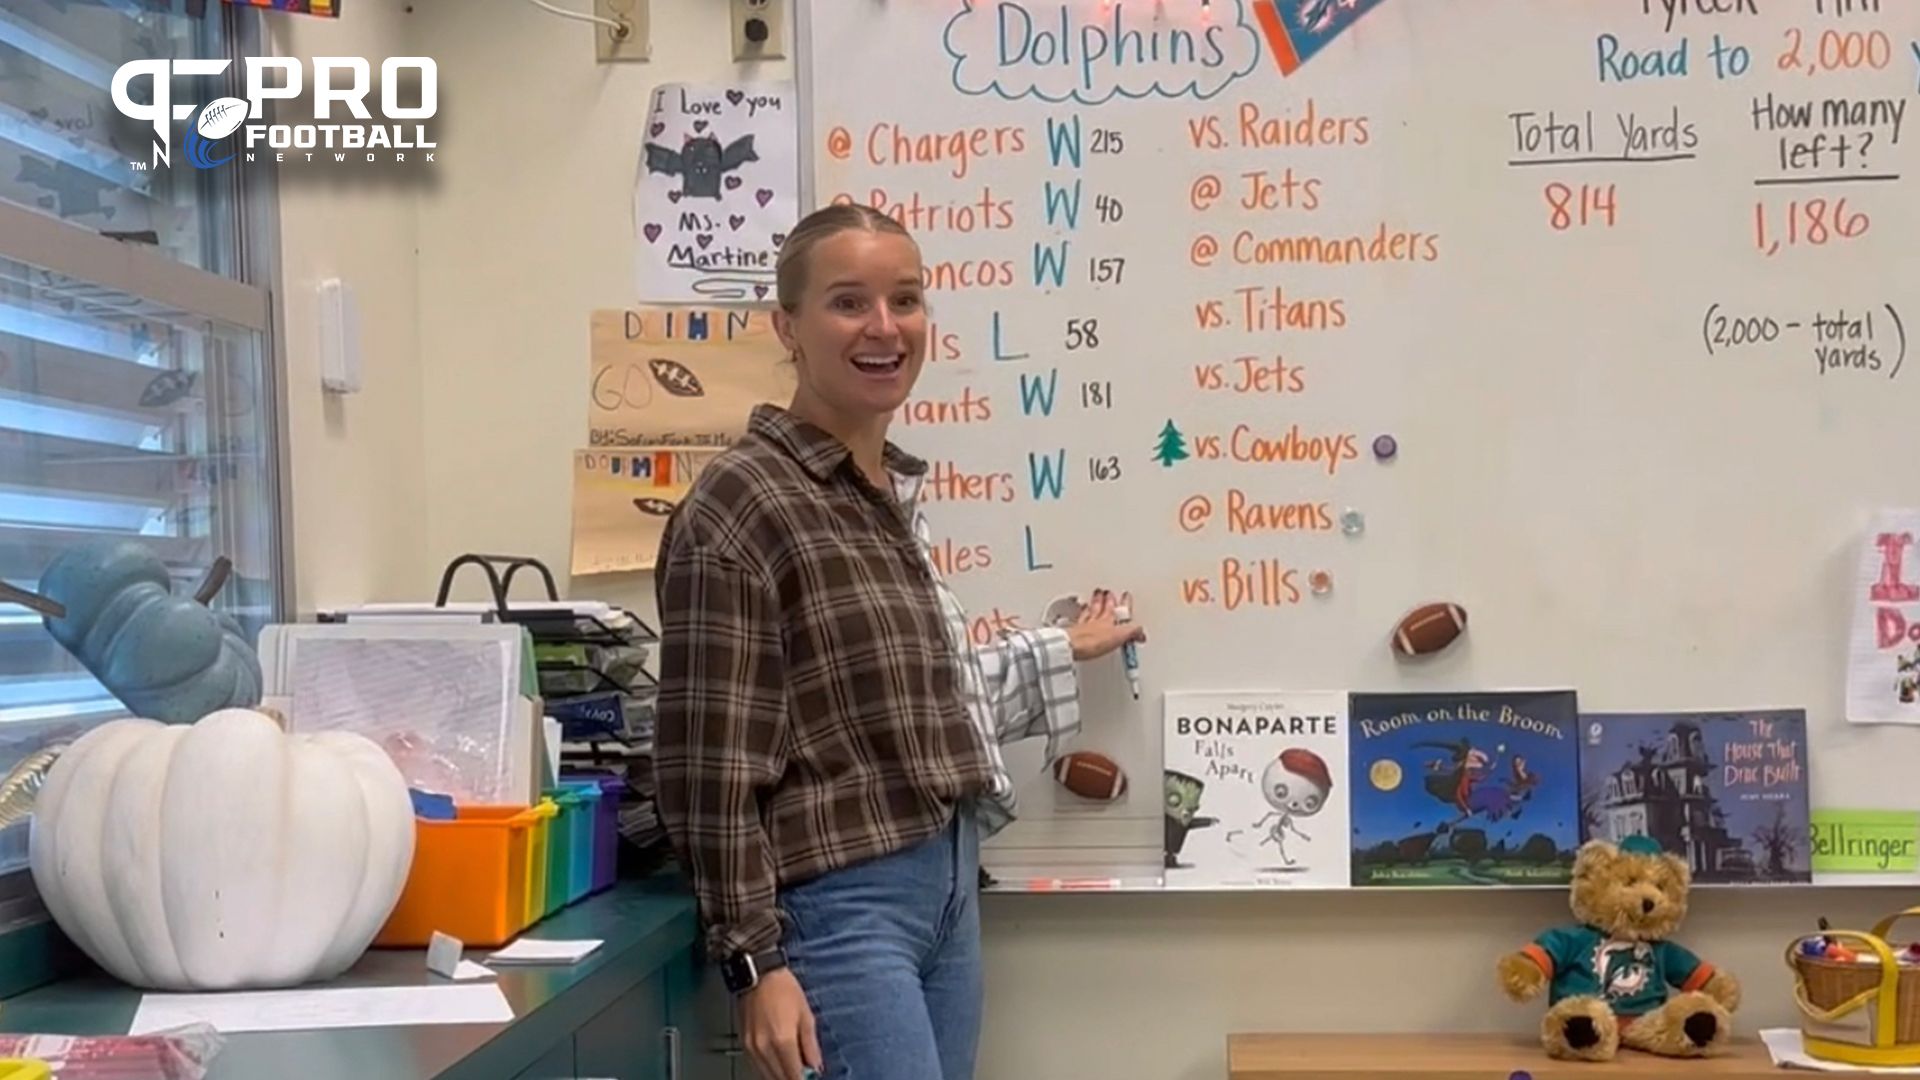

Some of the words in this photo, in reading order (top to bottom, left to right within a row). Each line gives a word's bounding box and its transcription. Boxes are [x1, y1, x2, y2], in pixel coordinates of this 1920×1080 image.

[997, 2, 1224, 90] Dolphins
[1597, 33, 1689, 82] Road
[1707, 33, 1750, 80] to
[1777, 27, 1892, 76] 2,000
[653, 91, 665, 114] I
[680, 88, 722, 115] Love
[745, 95, 781, 117] you
[1188, 114, 1229, 149] vs.
[1239, 98, 1370, 148] Raiders
[1752, 93, 1813, 131] How
[1821, 98, 1906, 144] many
[827, 126, 852, 159] @
[868, 122, 1026, 179] Chargers
[1047, 114, 1081, 168] W
[1090, 128, 1124, 154] 215
[1508, 109, 1593, 154] Total
[1617, 106, 1699, 159] Yards
[1779, 132, 1873, 170] left?
[870, 187, 1014, 233] Patriots
[1045, 179, 1081, 229] W
[1095, 194, 1123, 223] 40
[1190, 175, 1222, 210] @
[1240, 168, 1322, 210] Jets
[1544, 182, 1617, 230] 814
[1190, 235, 1218, 267] @
[1233, 222, 1439, 264] Commanders
[1755, 198, 1870, 256] 1,186
[922, 258, 1014, 291] oncos
[1034, 241, 1070, 287] W
[1089, 258, 1125, 283] 157
[1196, 301, 1231, 329] vs.
[1235, 286, 1346, 332] Titans
[1812, 310, 1873, 342] total
[993, 311, 1029, 360] L
[1065, 318, 1100, 350] 58
[904, 387, 992, 425] iants
[1021, 368, 1056, 416] W
[1082, 382, 1112, 408] 181
[1195, 364, 1229, 391] vs.
[1233, 355, 1305, 393] Jets
[1194, 434, 1227, 459] vs.
[1231, 424, 1358, 474] Cowboys
[921, 461, 1015, 502] thers
[1029, 448, 1065, 500] W
[1089, 456, 1122, 480] 163
[1179, 495, 1212, 532] @
[1228, 489, 1332, 534] Ravens
[1025, 525, 1053, 571] L
[1182, 578, 1215, 602] vs.
[1223, 557, 1300, 610] Bills
[1177, 716, 1337, 736] BONAPARTE
[1360, 711, 1421, 739] Room
[1426, 707, 1453, 722] on
[1458, 704, 1491, 721] the
[1500, 705, 1564, 740] Broom
[1749, 719, 1774, 739] The
[1194, 739, 1234, 760] Falls
[1205, 760, 1254, 784] Apart
[1724, 741, 1763, 763] House
[1809, 822, 1915, 869] Bellringer
